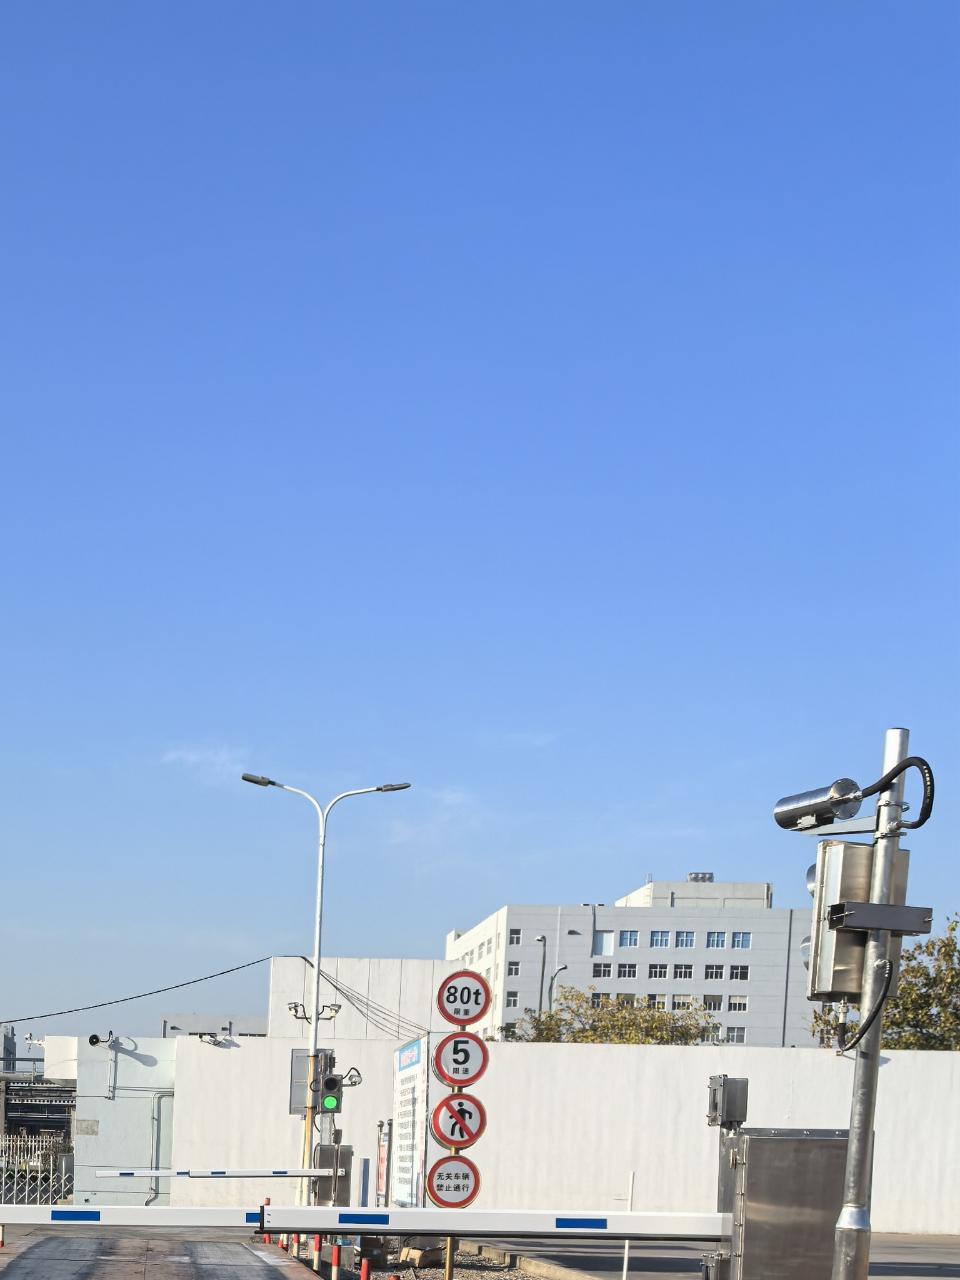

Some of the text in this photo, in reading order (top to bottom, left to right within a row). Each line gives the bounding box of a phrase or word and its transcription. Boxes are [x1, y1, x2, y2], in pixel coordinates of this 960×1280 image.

[446, 985, 482, 1006] 80t
[453, 1007, 470, 1016] 限重
[452, 1039, 470, 1066] 5
[452, 1067, 470, 1075] 限速
[436, 1172, 470, 1181] 无关车辆
[436, 1183, 470, 1192] 禁止通行
